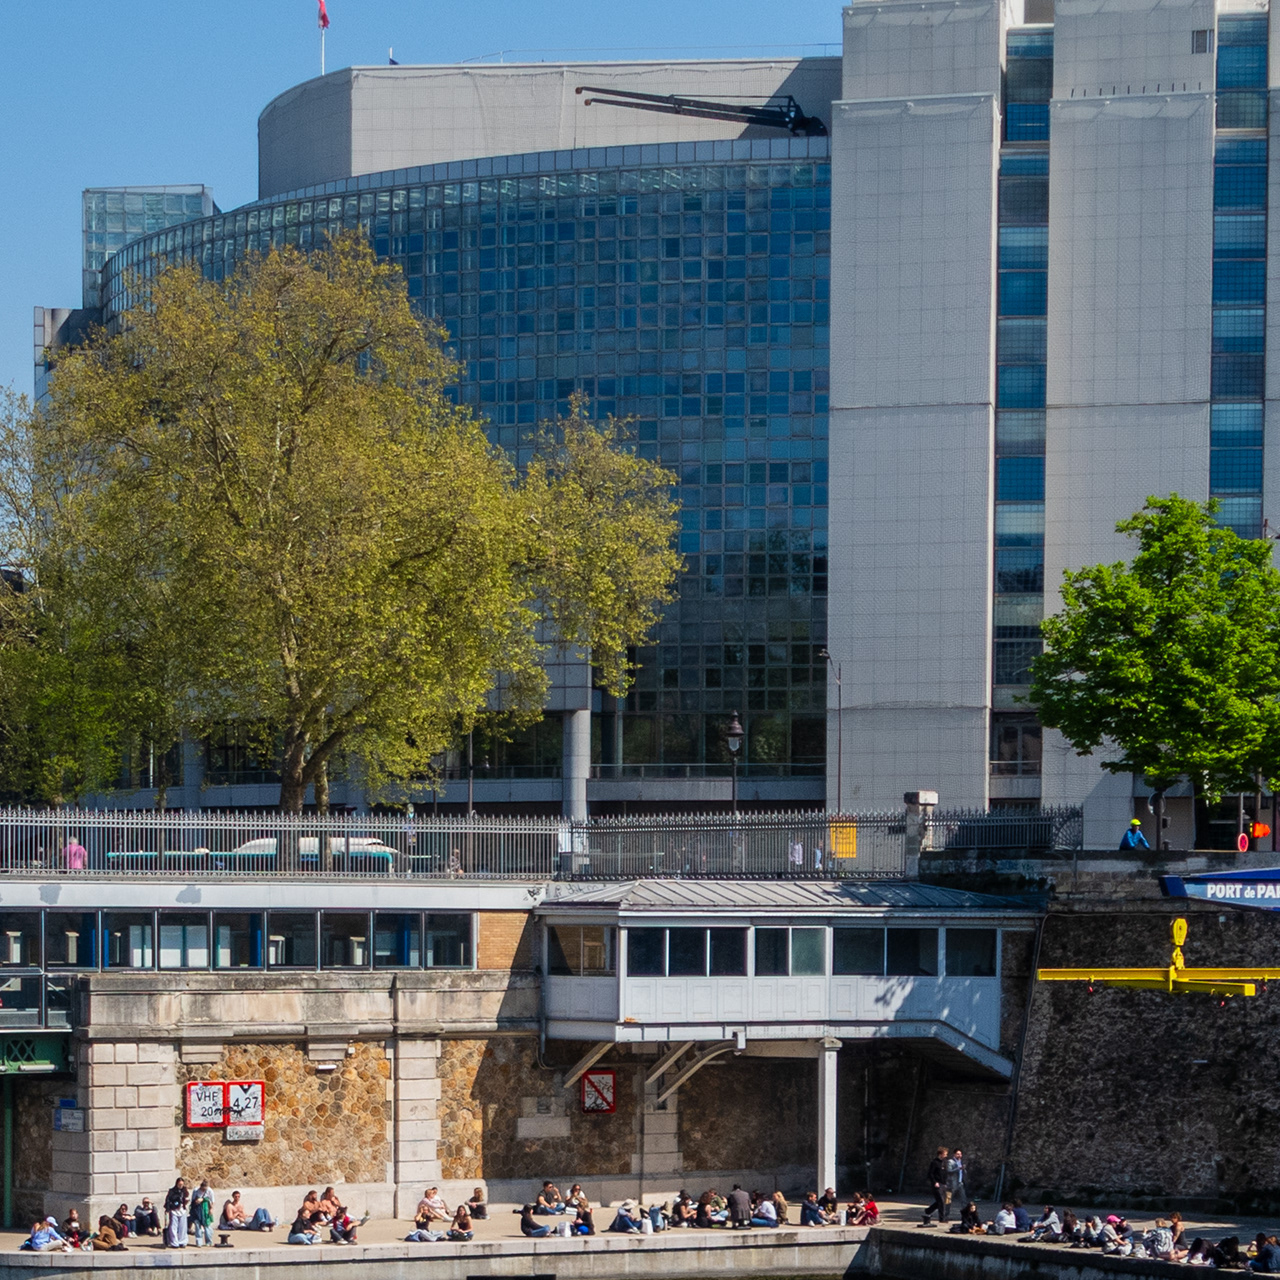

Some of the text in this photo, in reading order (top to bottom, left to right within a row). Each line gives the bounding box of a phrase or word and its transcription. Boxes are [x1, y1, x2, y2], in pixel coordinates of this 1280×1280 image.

[1206, 883, 1242, 898] PORT
[1244, 885, 1255, 898] de
[196, 1091, 218, 1102] VHF
